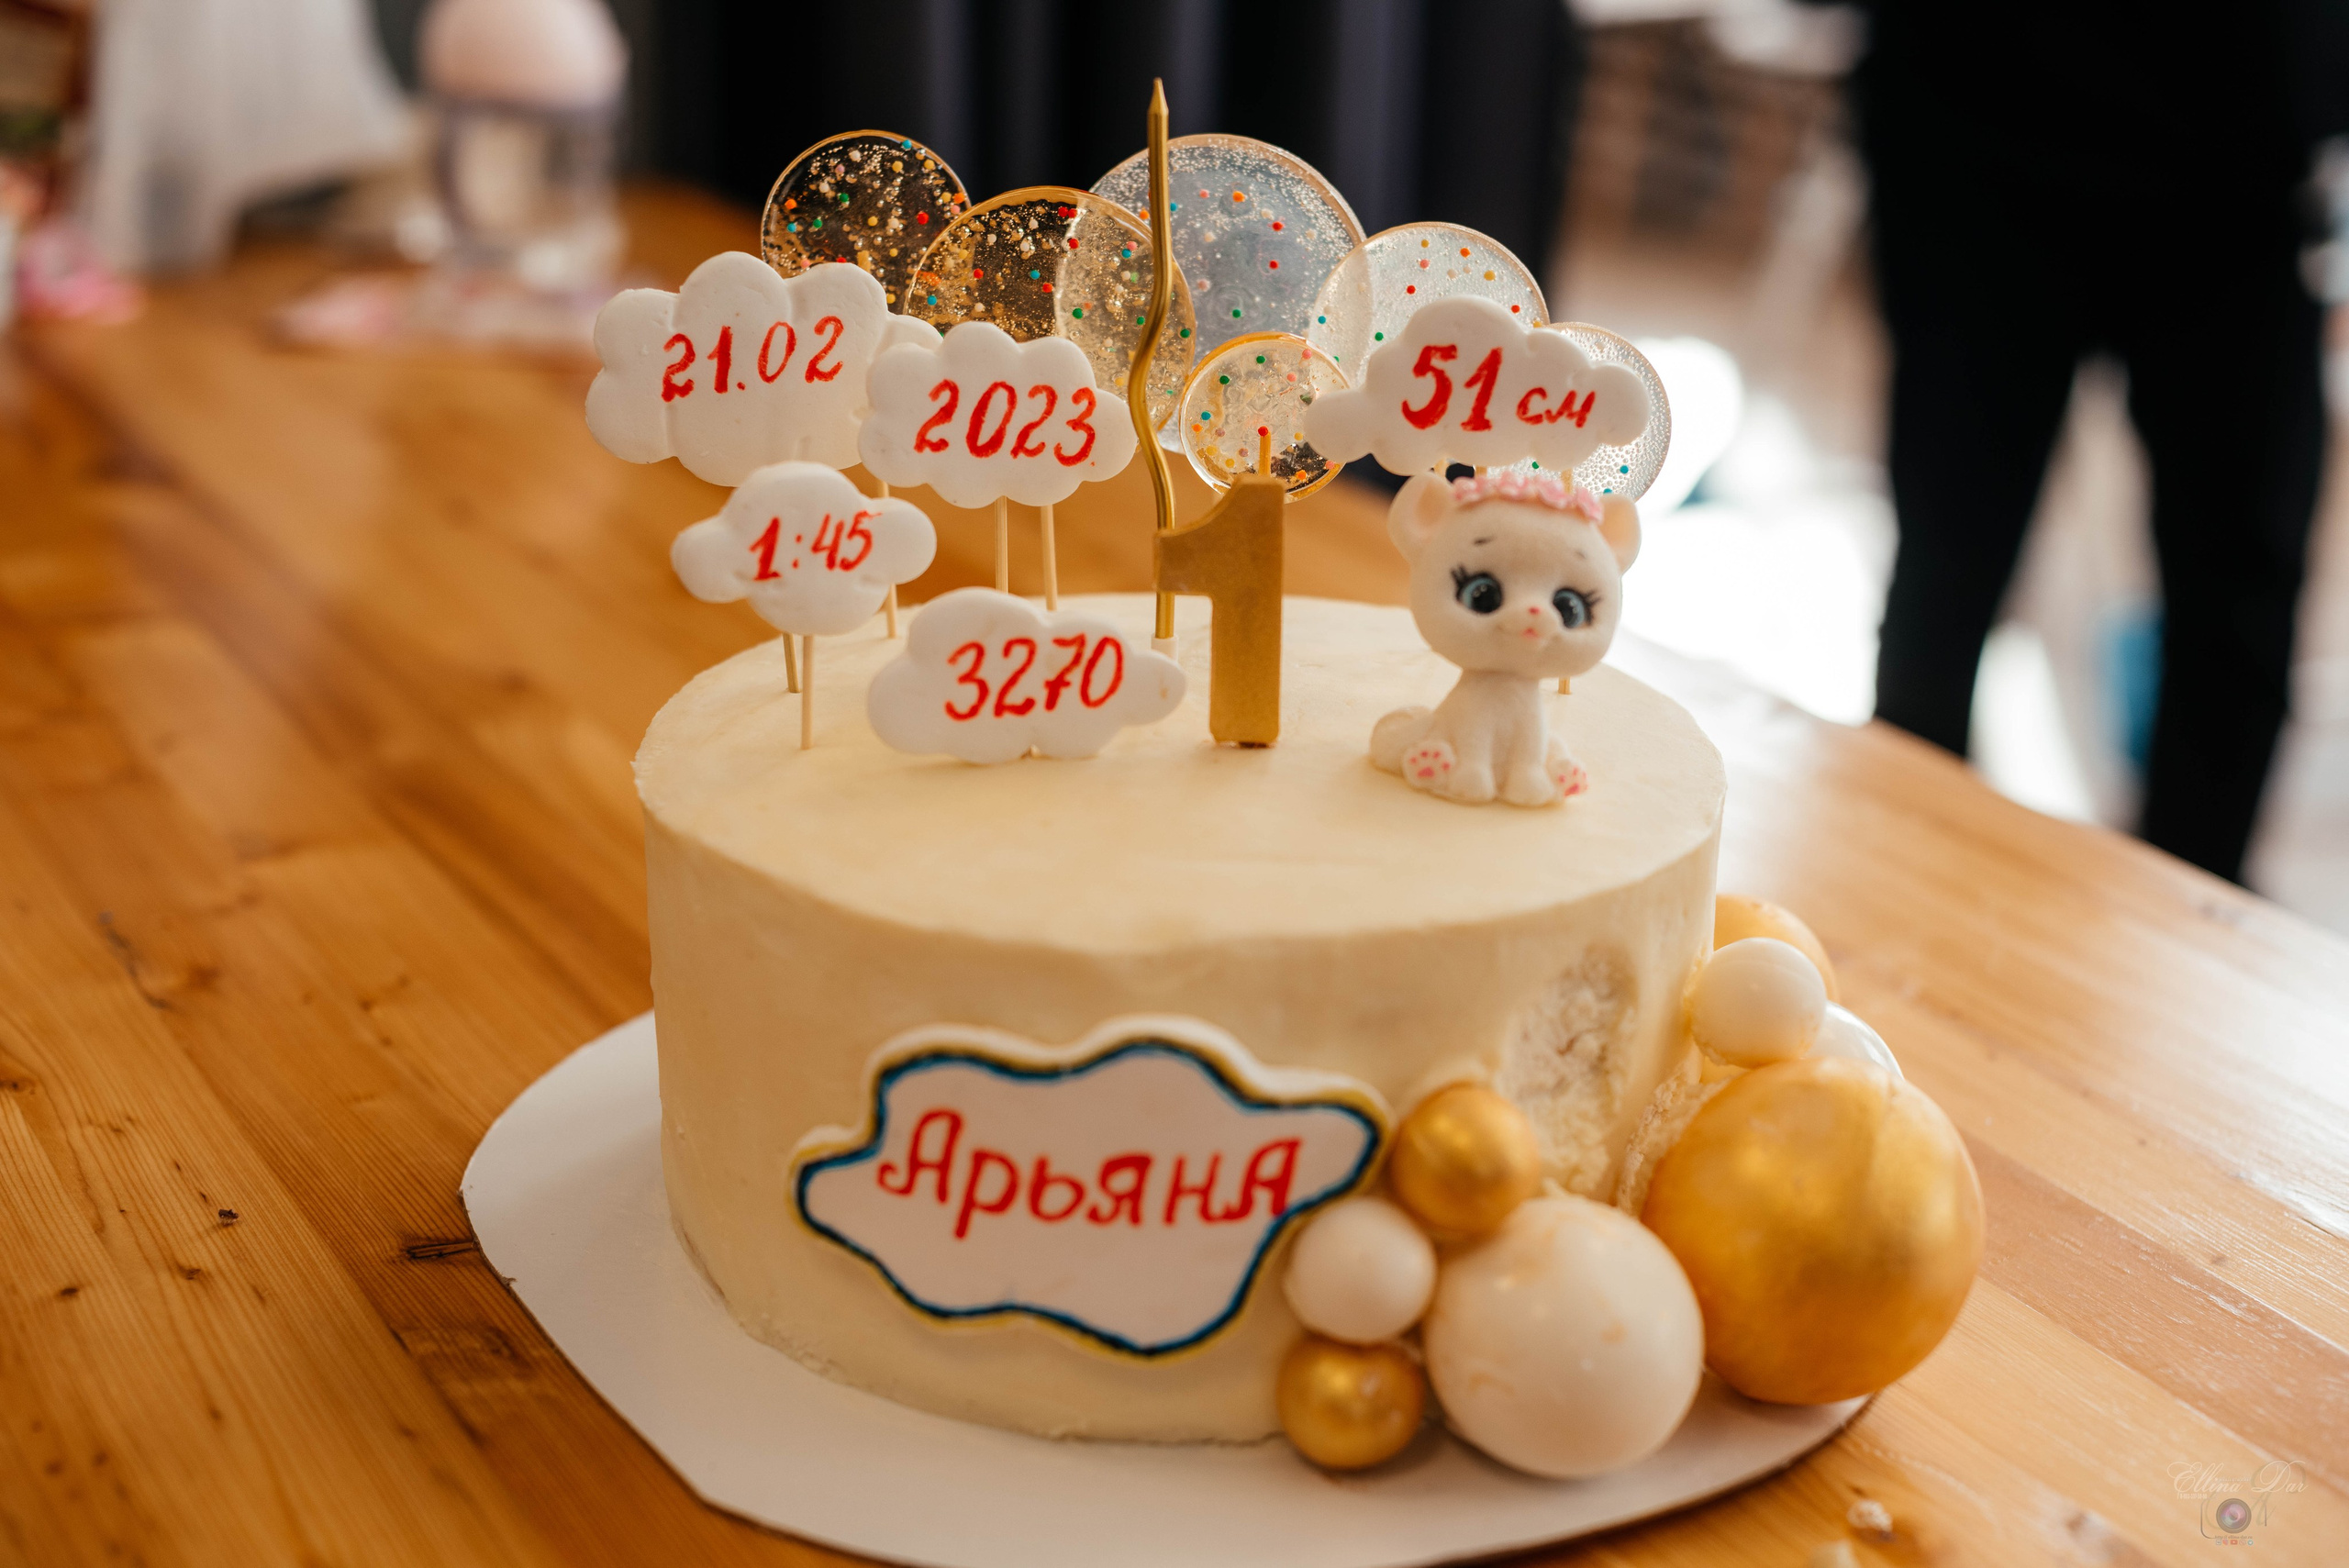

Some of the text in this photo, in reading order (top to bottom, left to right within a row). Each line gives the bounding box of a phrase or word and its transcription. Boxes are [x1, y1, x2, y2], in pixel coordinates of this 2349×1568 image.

[659, 316, 845, 404] 21.02
[1401, 343, 1597, 432] 51 см
[749, 510, 882, 583] 1:45
[1153, 473, 1285, 747] 1
[944, 632, 1125, 722] 3270
